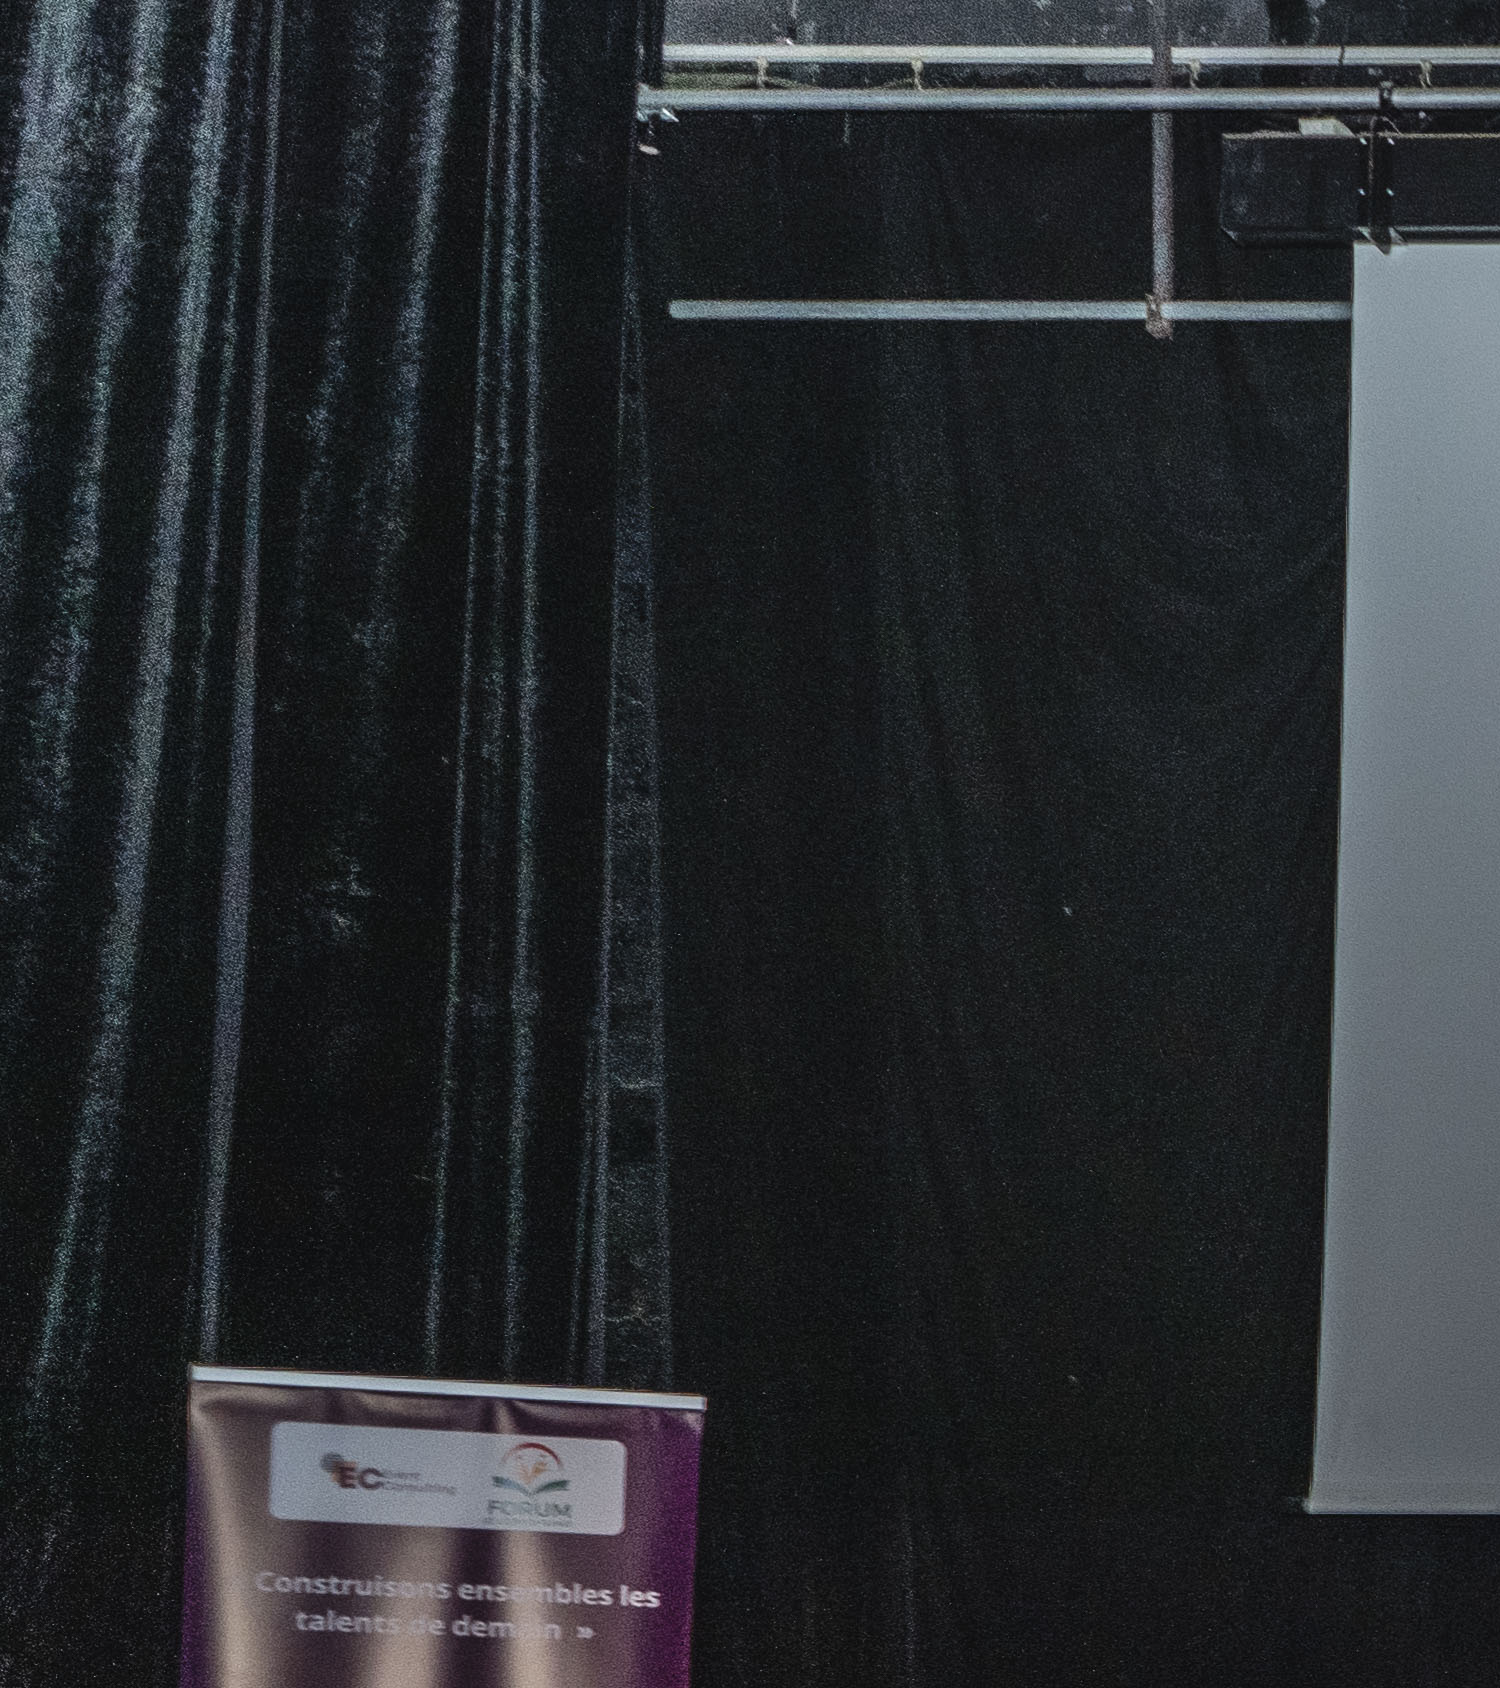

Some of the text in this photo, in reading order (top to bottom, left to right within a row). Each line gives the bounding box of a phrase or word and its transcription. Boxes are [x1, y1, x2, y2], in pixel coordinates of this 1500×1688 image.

[341, 1461, 382, 1490] EC
[487, 1500, 573, 1520] FORUM
[255, 1571, 451, 1600] Construisons
[621, 1585, 661, 1610] les
[452, 1615, 562, 1641] demn
